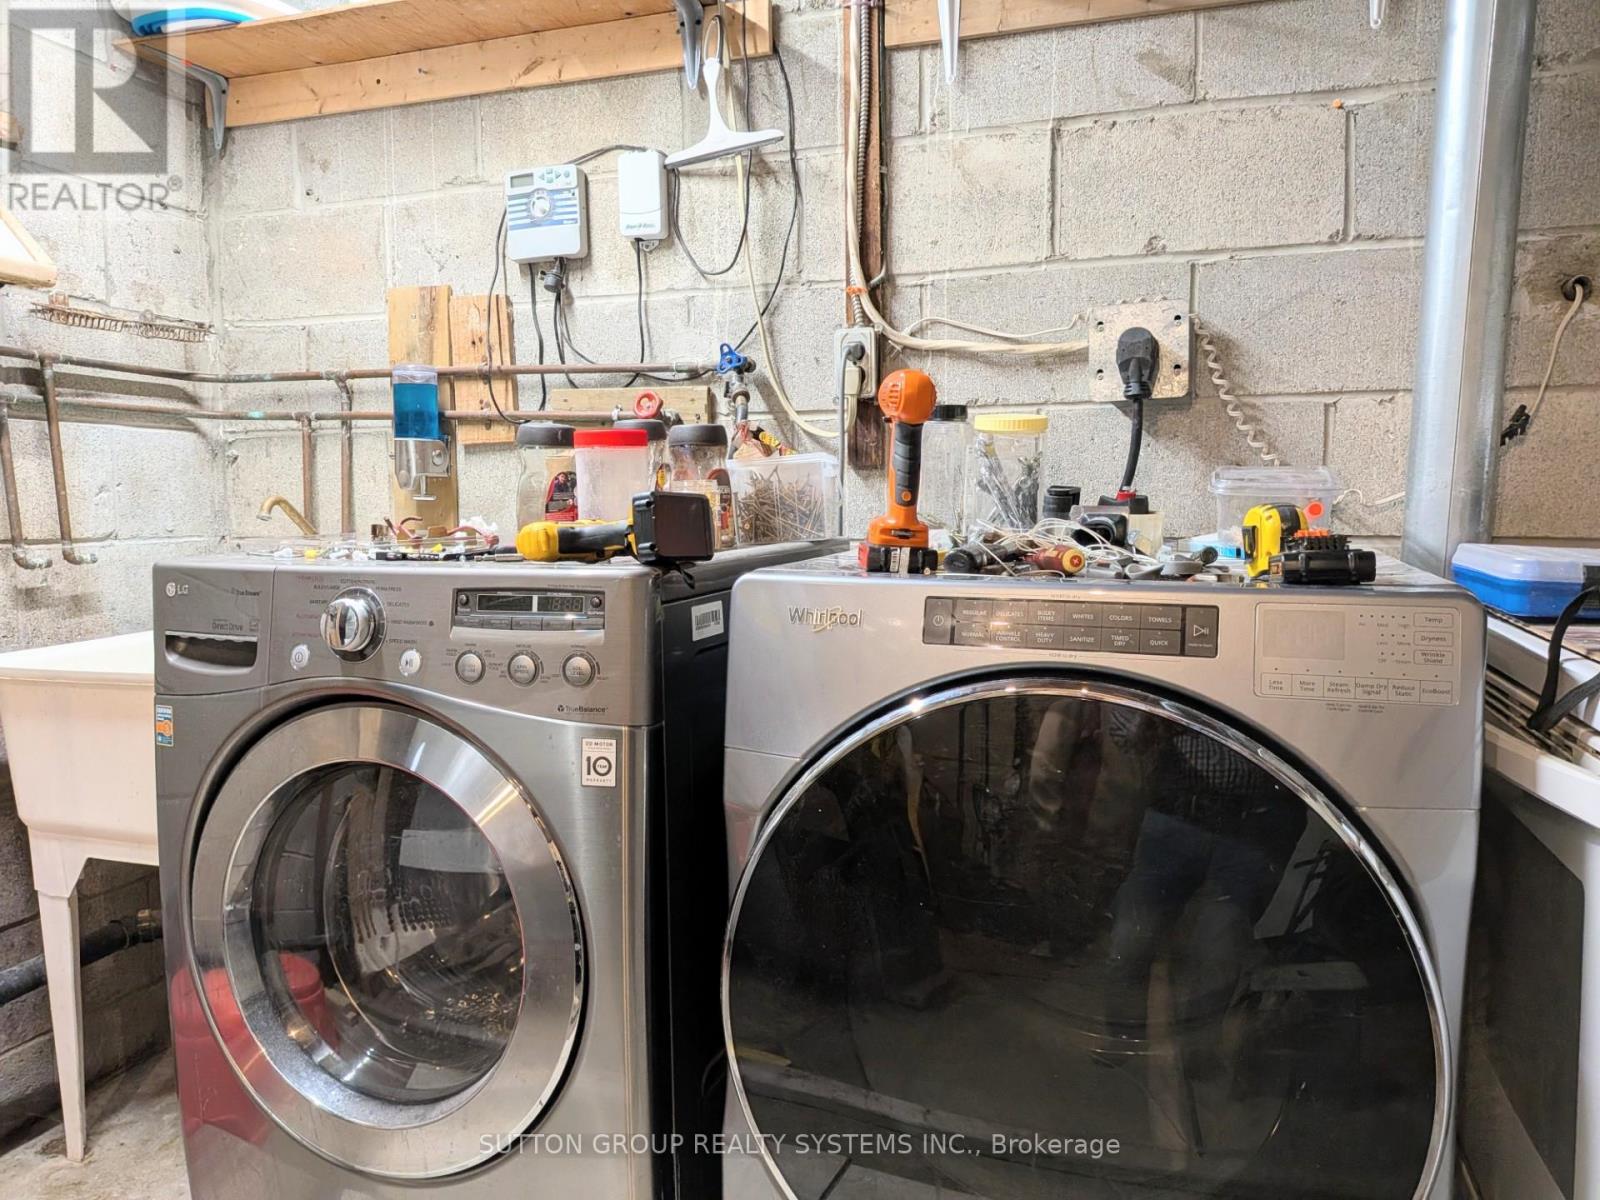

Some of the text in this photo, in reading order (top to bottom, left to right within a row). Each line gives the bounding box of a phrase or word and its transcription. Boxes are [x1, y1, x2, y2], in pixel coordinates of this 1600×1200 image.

[788, 607, 863, 629] Whirlpool
[1149, 639, 1168, 647] QUICK
[1420, 635, 1447, 643] Dryness
[586, 755, 612, 777] 10
